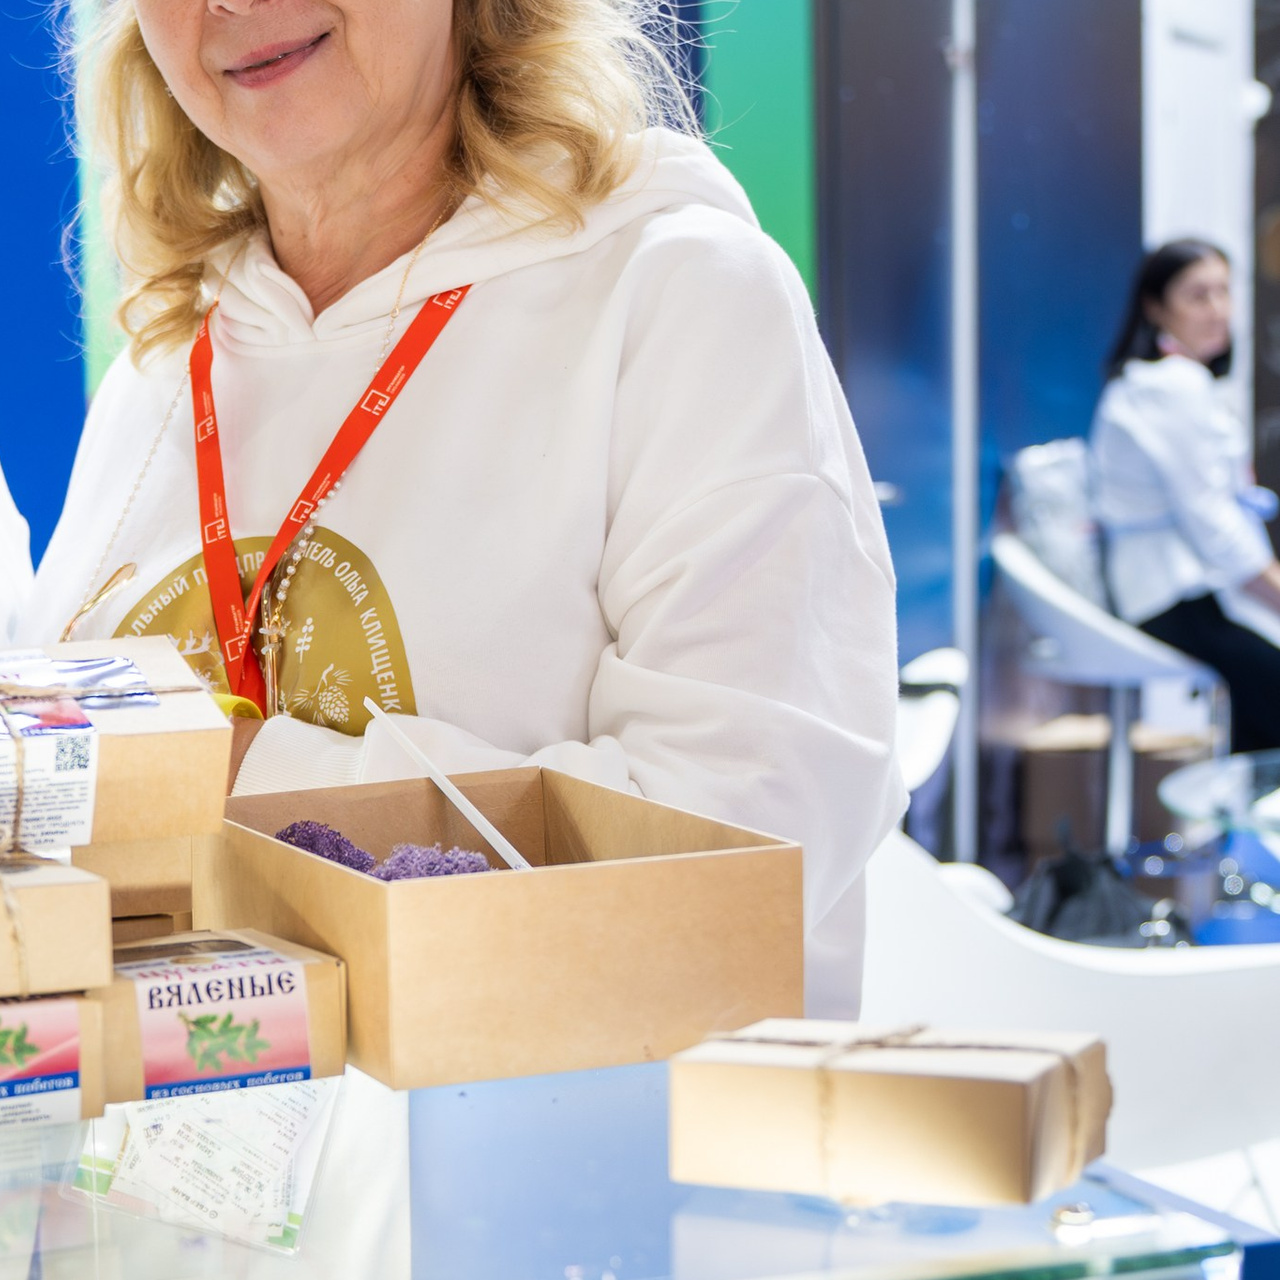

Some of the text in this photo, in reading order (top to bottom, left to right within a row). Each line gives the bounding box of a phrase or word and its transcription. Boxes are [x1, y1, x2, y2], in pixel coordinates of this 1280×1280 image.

[130, 575, 190, 637] ЛЬНЫЙ
[334, 561, 369, 607] ОЛЬГА
[359, 606, 402, 712] КЛИЩЕНК
[147, 970, 297, 1010] ВЯЛЕНЫЕ
